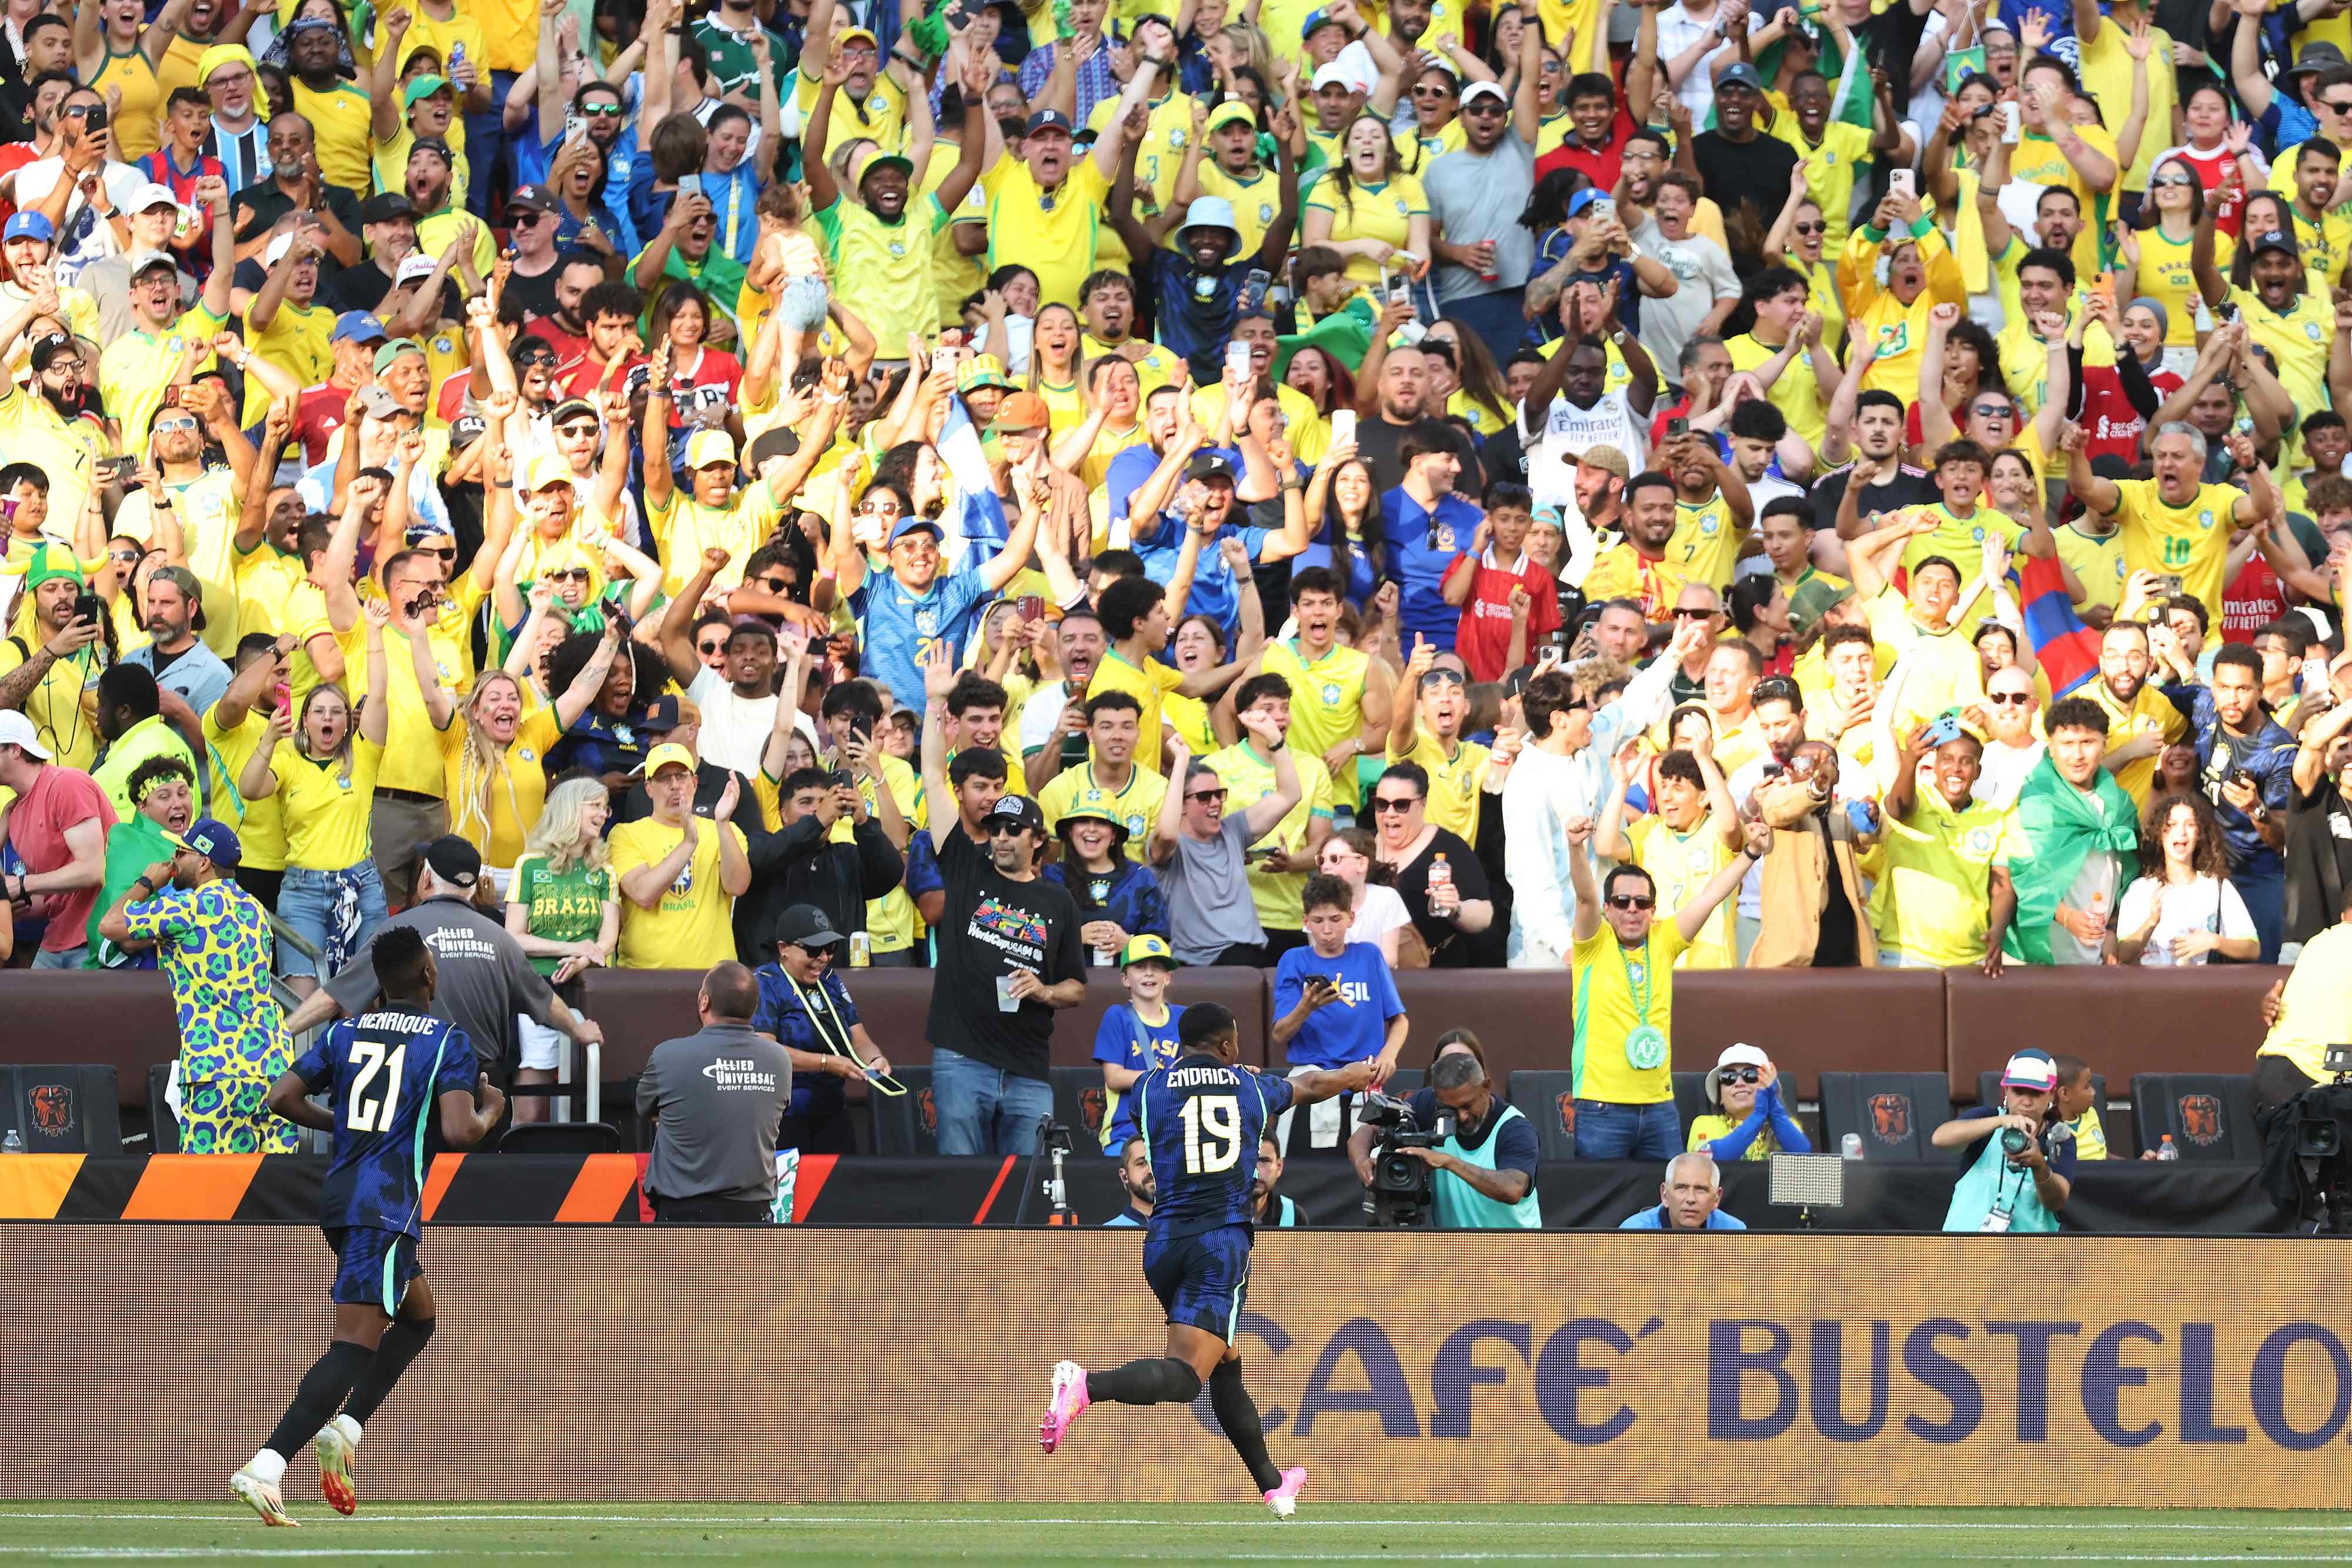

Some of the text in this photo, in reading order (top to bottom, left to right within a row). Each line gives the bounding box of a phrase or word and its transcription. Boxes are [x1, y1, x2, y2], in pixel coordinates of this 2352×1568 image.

[1147, 155, 1158, 183] 3
[1875, 319, 1908, 360] 23
[1000, 401, 1013, 417] C
[75, 449, 85, 470] 7
[1684, 545, 1695, 563] 7
[2164, 536, 2190, 564] 10
[2224, 598, 2278, 616] mirates
[533, 884, 599, 900] BRAZI
[533, 897, 600, 917] BRAZI
[662, 899, 696, 911] BRASIL
[437, 926, 474, 939] ALLIED
[438, 940, 495, 955] UNIVERSAL
[464, 952, 496, 961] SERVICES
[356, 1012, 439, 1035] HENRIQUE
[1131, 1037, 1180, 1059] BASI
[715, 1058, 754, 1071] ALLIED
[348, 1040, 407, 1133] 21
[716, 1071, 776, 1085] UNIVERSAL
[1166, 1066, 1241, 1088] ENDRICK
[1177, 1094, 1242, 1175] 19
[1706, 1316, 2351, 1452] BUSTELO
